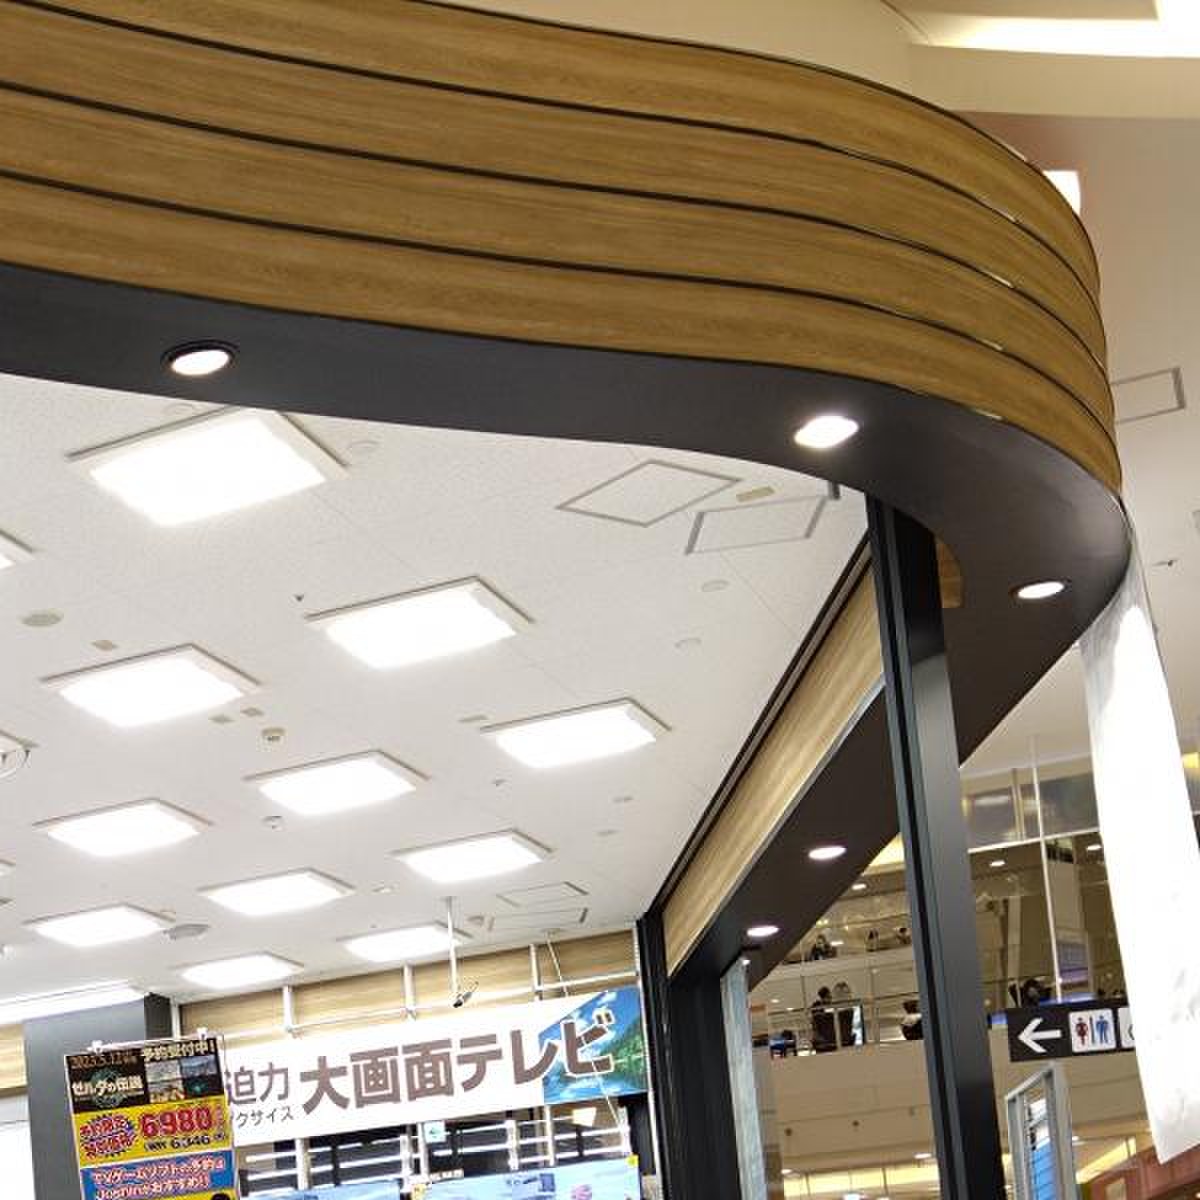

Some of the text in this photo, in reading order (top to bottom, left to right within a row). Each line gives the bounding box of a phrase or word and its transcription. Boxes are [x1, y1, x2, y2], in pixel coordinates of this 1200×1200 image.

[300, 1010, 616, 1114] 大画面テレビ
